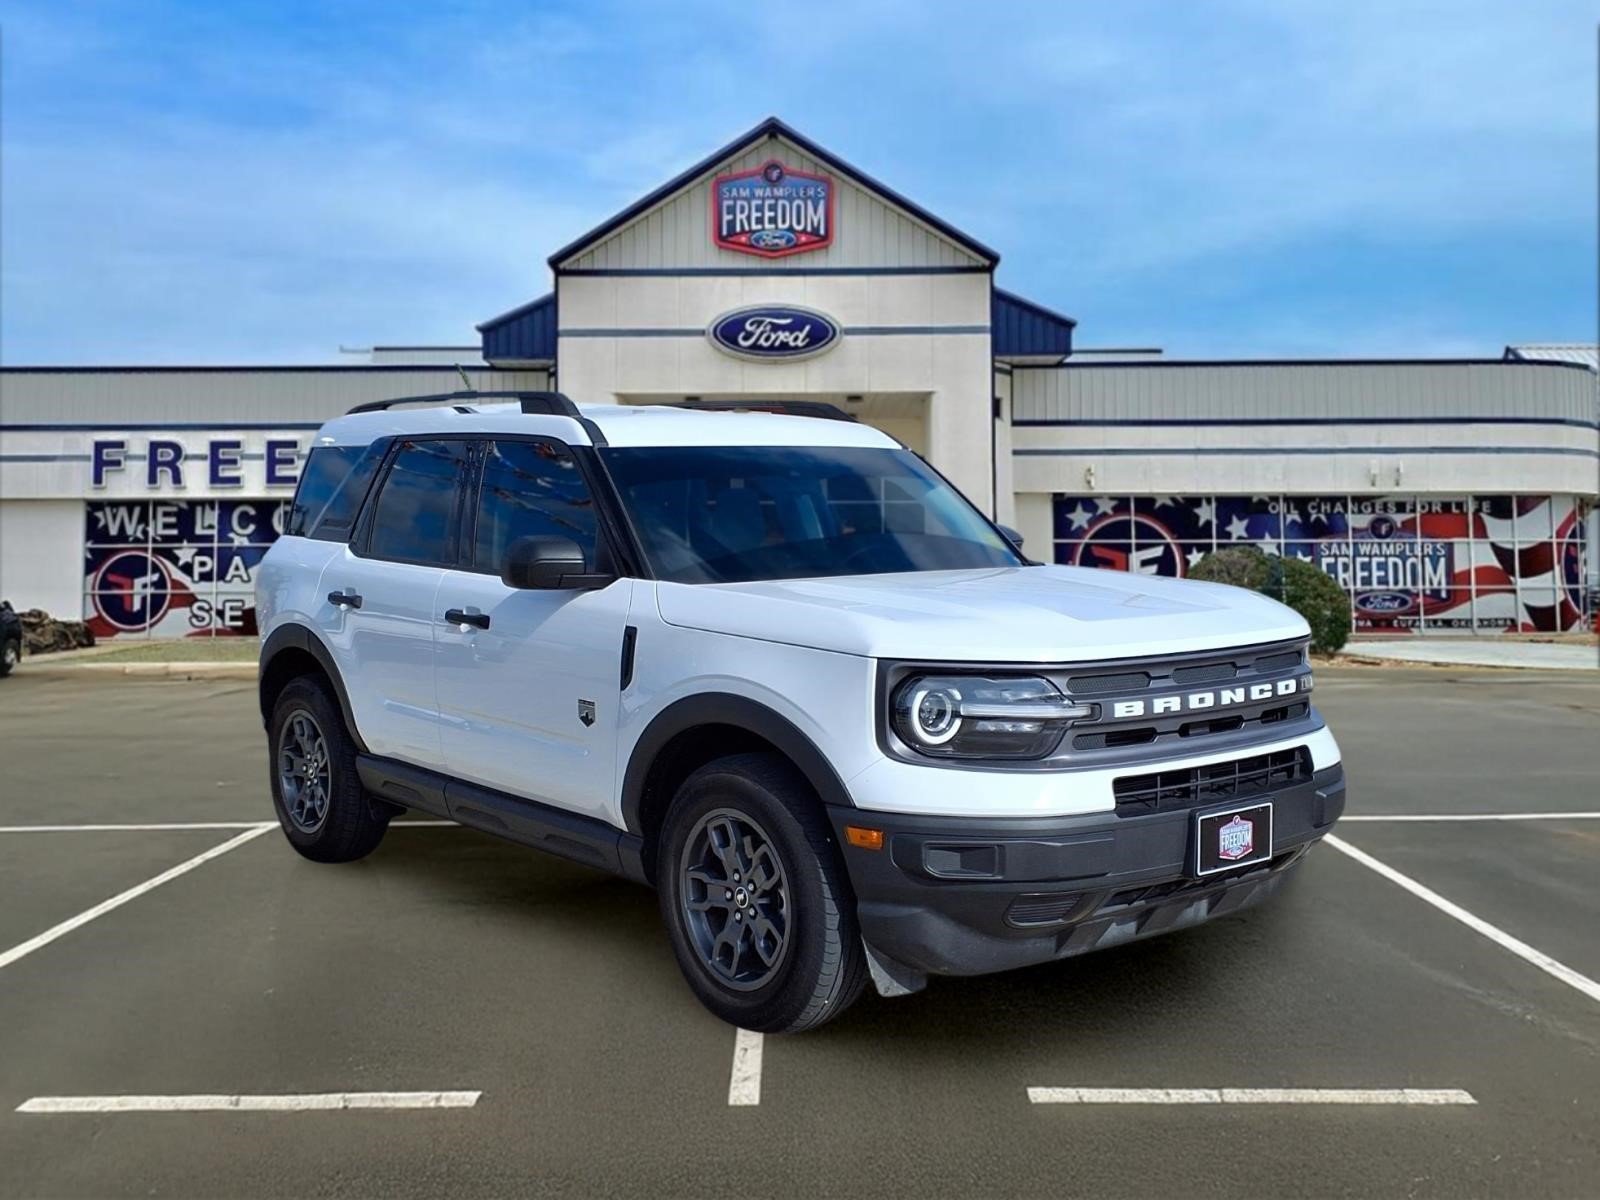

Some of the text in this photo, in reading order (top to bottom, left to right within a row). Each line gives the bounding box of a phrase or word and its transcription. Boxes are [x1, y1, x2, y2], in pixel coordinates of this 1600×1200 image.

[722, 187, 750, 198] SAM
[721, 200, 826, 236] FREEDOM
[737, 316, 812, 348] Ford
[1268, 501, 1491, 513] OIL CHANGES FOR LIFE
[1365, 595, 1400, 609] Ford
[1113, 678, 1297, 718] BRONCO
